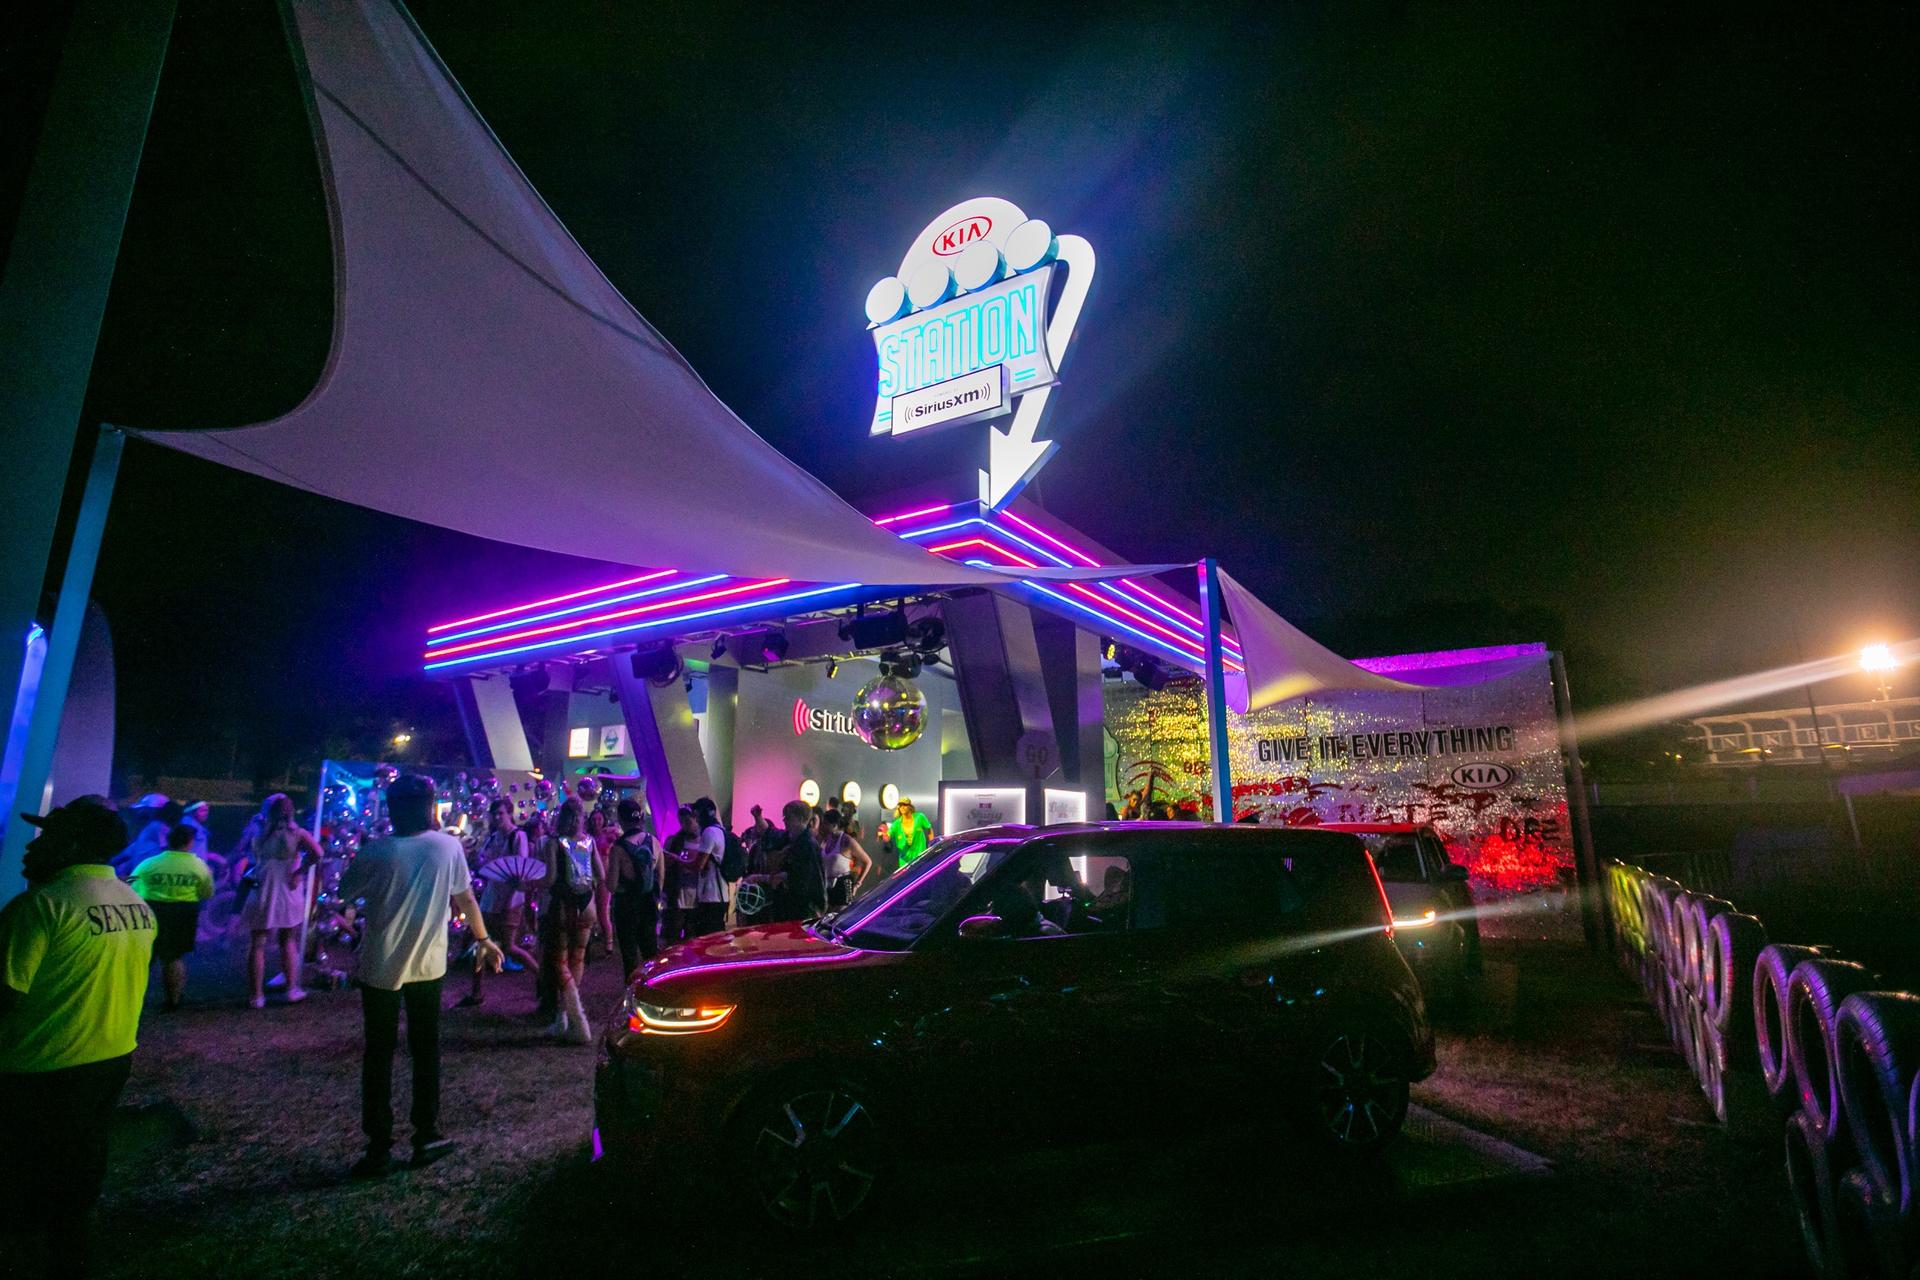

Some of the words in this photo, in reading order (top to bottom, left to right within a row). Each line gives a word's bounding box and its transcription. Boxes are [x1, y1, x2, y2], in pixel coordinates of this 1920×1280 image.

[942, 222, 982, 251] KIA
[879, 285, 1036, 398] STATION
[810, 708, 858, 736] Siriu
[1257, 736, 1308, 762] GIVE
[1319, 735, 1341, 760] IT
[1352, 726, 1514, 759] EVERYTHING
[1461, 768, 1501, 783] KIA
[87, 902, 154, 936] SENTR
